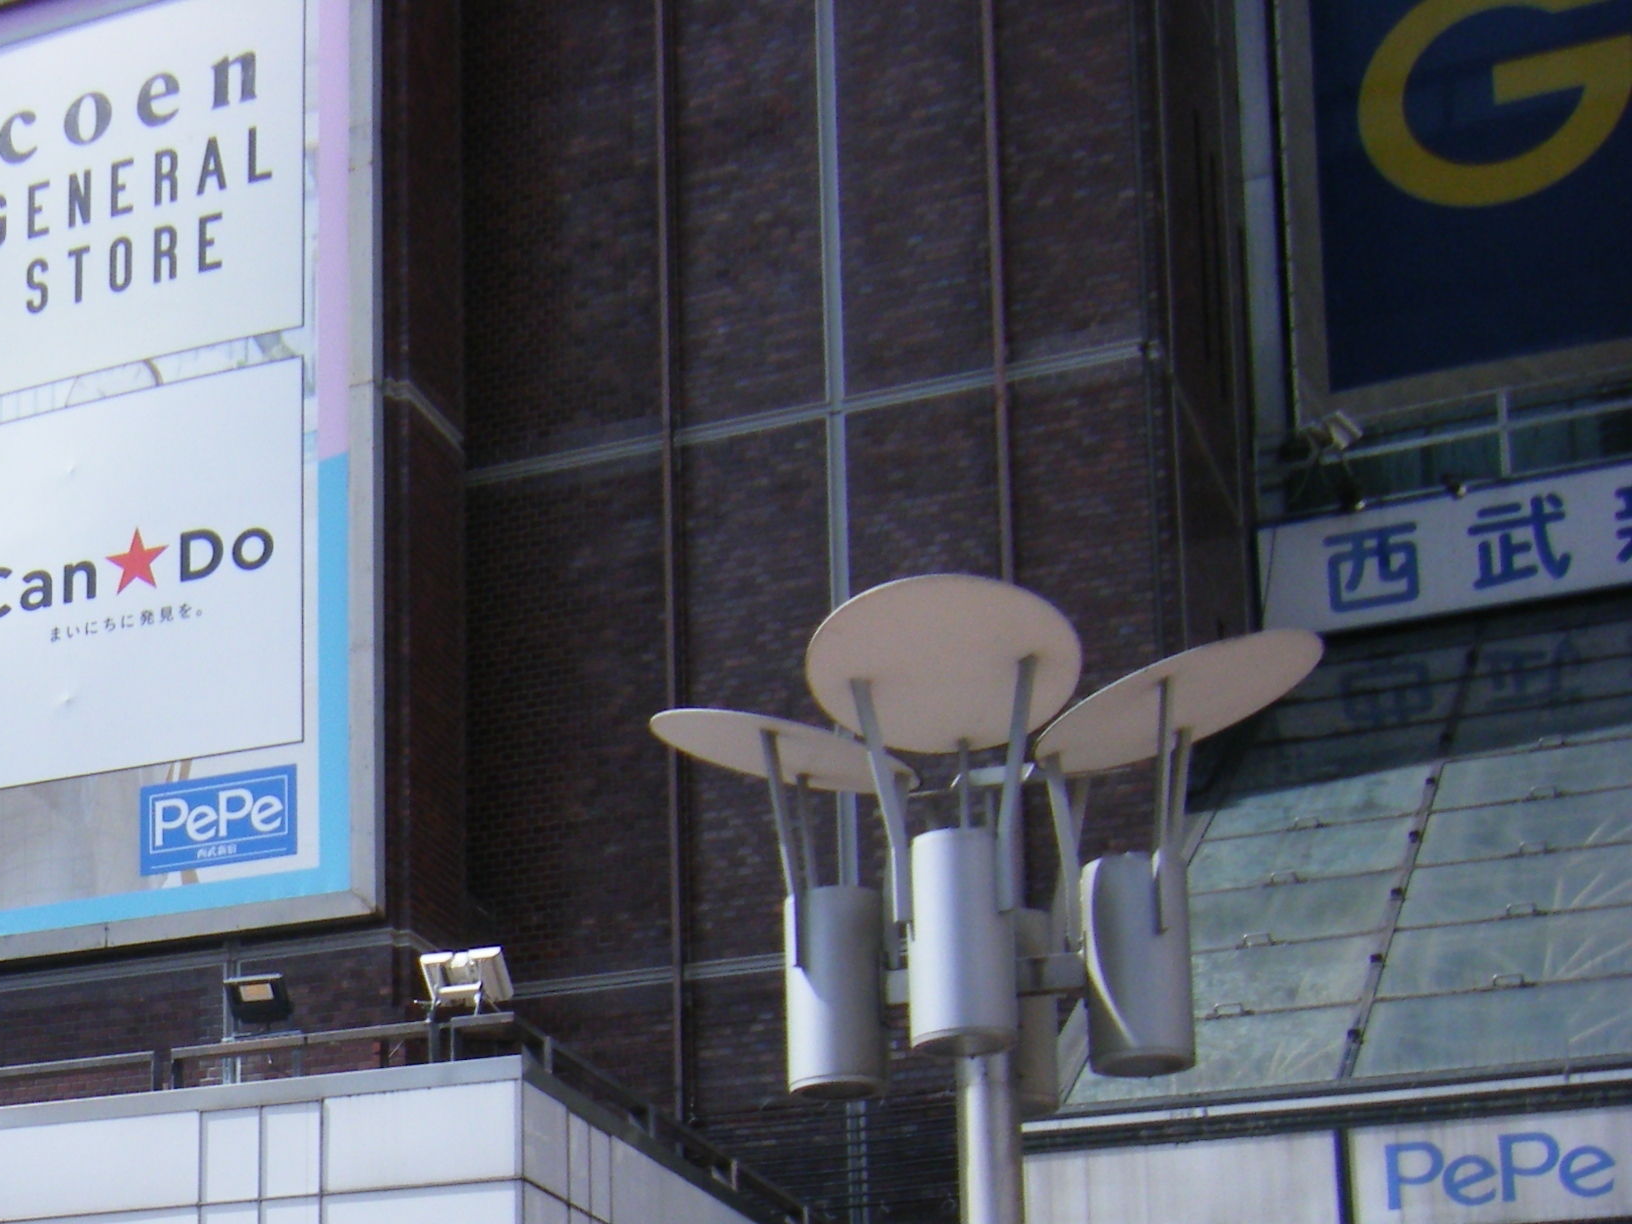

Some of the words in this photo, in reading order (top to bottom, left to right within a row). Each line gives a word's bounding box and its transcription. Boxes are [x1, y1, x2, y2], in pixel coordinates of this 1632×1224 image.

[26, 212, 223, 313] STORE
[179, 528, 275, 583] Do
[50, 603, 204, 643] まいにちに発見を。
[153, 788, 285, 847] PePe
[1385, 1132, 1615, 1210] PePe
